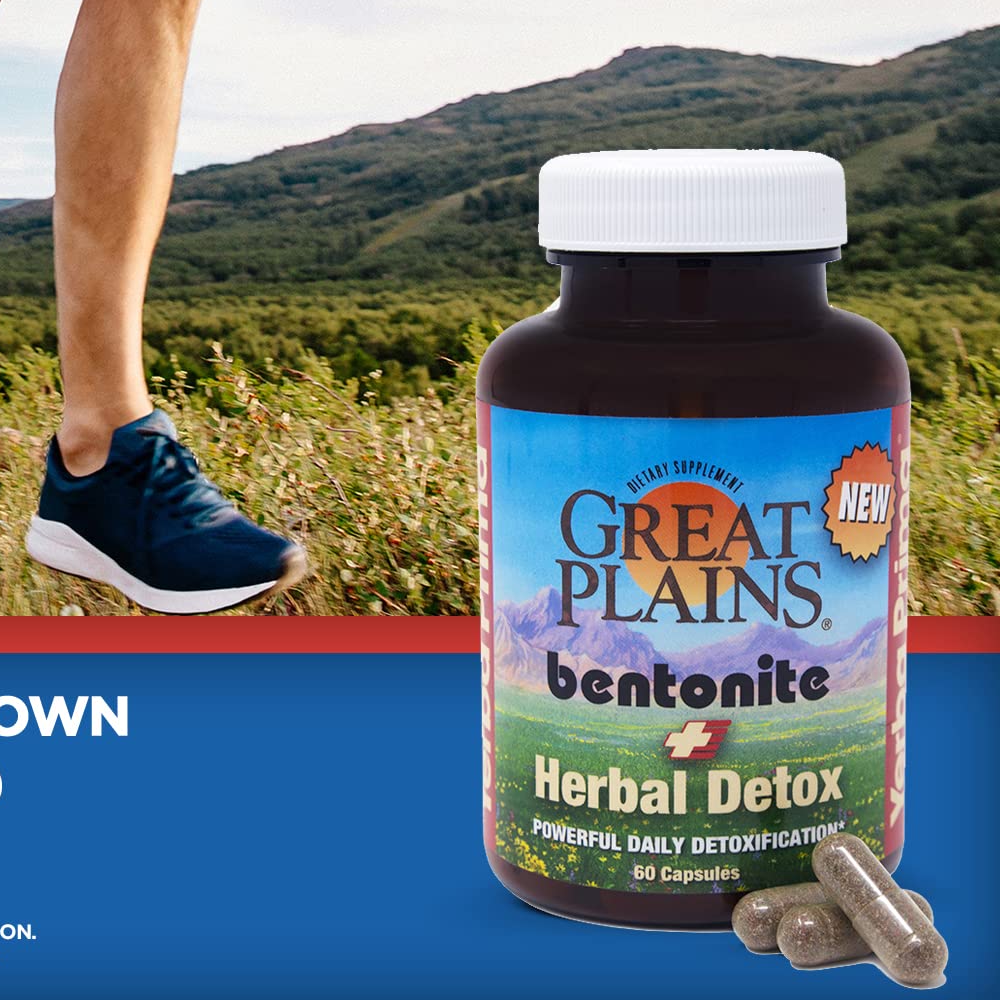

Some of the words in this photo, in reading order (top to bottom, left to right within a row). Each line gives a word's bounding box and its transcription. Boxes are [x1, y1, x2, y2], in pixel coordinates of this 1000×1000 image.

[626, 462, 669, 494] DIETARY
[673, 459, 744, 494] SUPPLEMENT
[837, 481, 891, 524] NEW
[560, 489, 811, 562] GREAT
[546, 650, 831, 709] bentonite
[534, 753, 687, 815] Herbal
[707, 765, 844, 815] Detox
[532, 818, 622, 853] POWERFUL
[627, 834, 686, 855] DAILY
[633, 864, 656, 882] 60
[660, 863, 741, 884] Capsules
